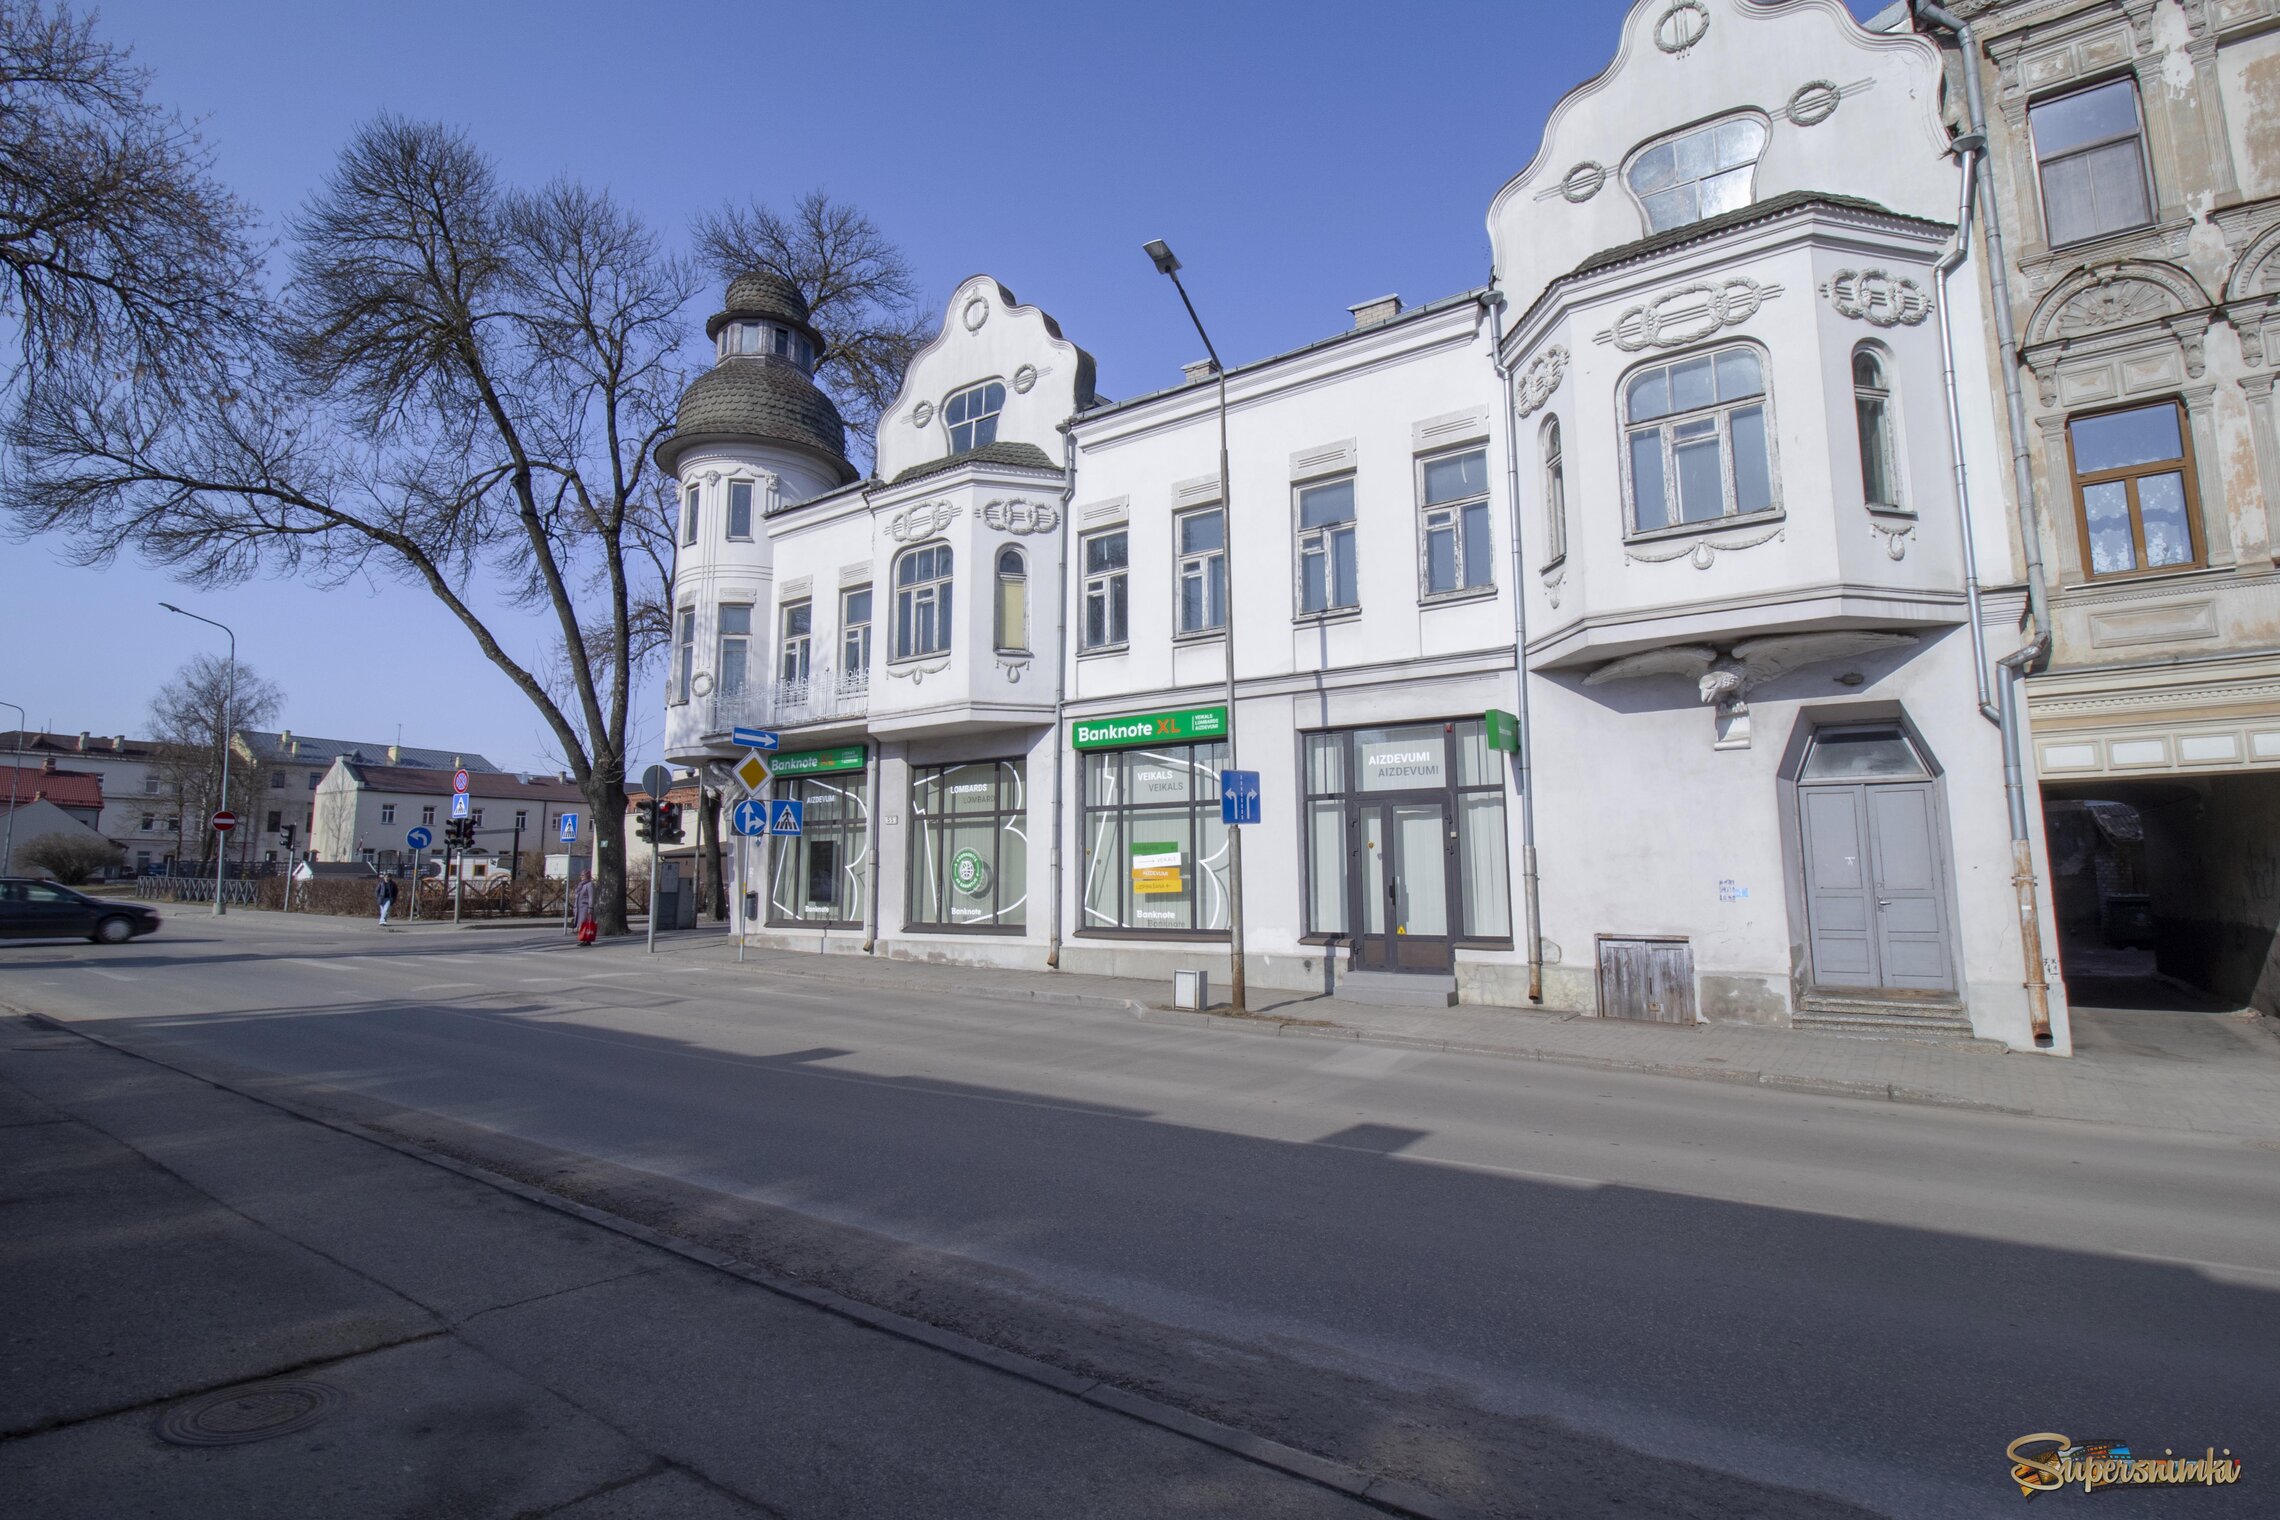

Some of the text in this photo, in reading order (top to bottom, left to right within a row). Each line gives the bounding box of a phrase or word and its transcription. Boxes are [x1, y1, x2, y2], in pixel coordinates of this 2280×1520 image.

[1078, 719, 1181, 742] Banknote XL
[771, 756, 818, 771] Banknote
[1368, 751, 1430, 766] AIZDEVUMI
[1137, 770, 1173, 781] VEIKALS
[950, 783, 988, 794] LOMBARDS
[805, 905, 830, 913] Banknote
[951, 907, 982, 915] Banknote
[1136, 909, 1176, 919] Banknote
